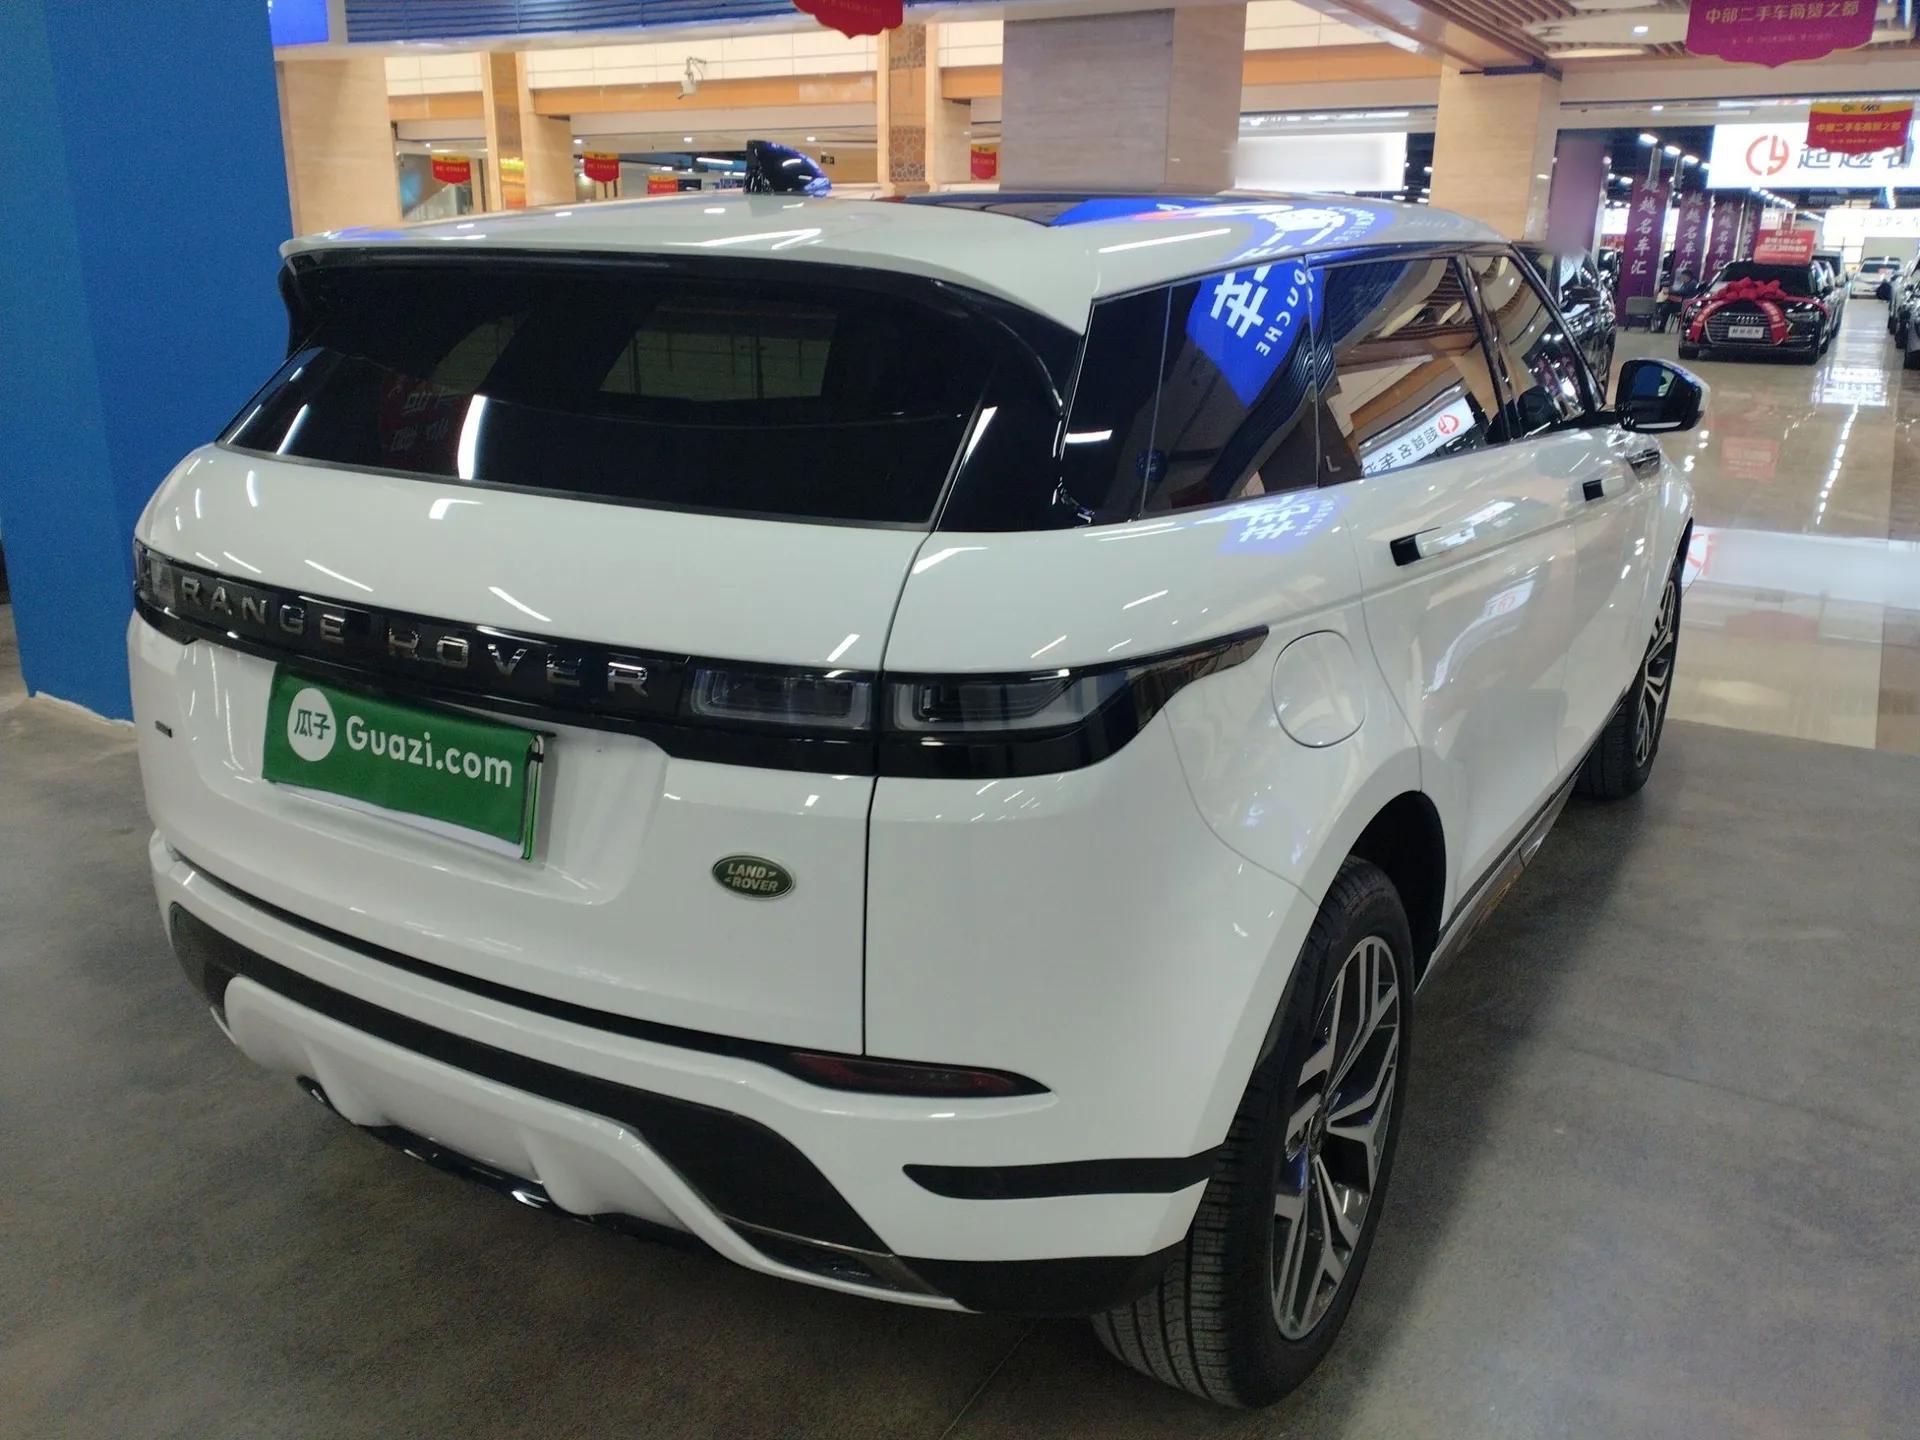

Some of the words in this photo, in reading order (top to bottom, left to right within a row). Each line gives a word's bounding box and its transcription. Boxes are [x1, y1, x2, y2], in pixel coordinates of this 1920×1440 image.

[1706, 2, 1859, 24] 中部二手车商贸之都
[180, 576, 347, 644] RANGE
[387, 624, 650, 698] ROVER
[294, 708, 331, 740] 瓜子
[346, 715, 513, 788] Guazi.com
[727, 863, 767, 879] LAND
[732, 877, 779, 892] ROVER
